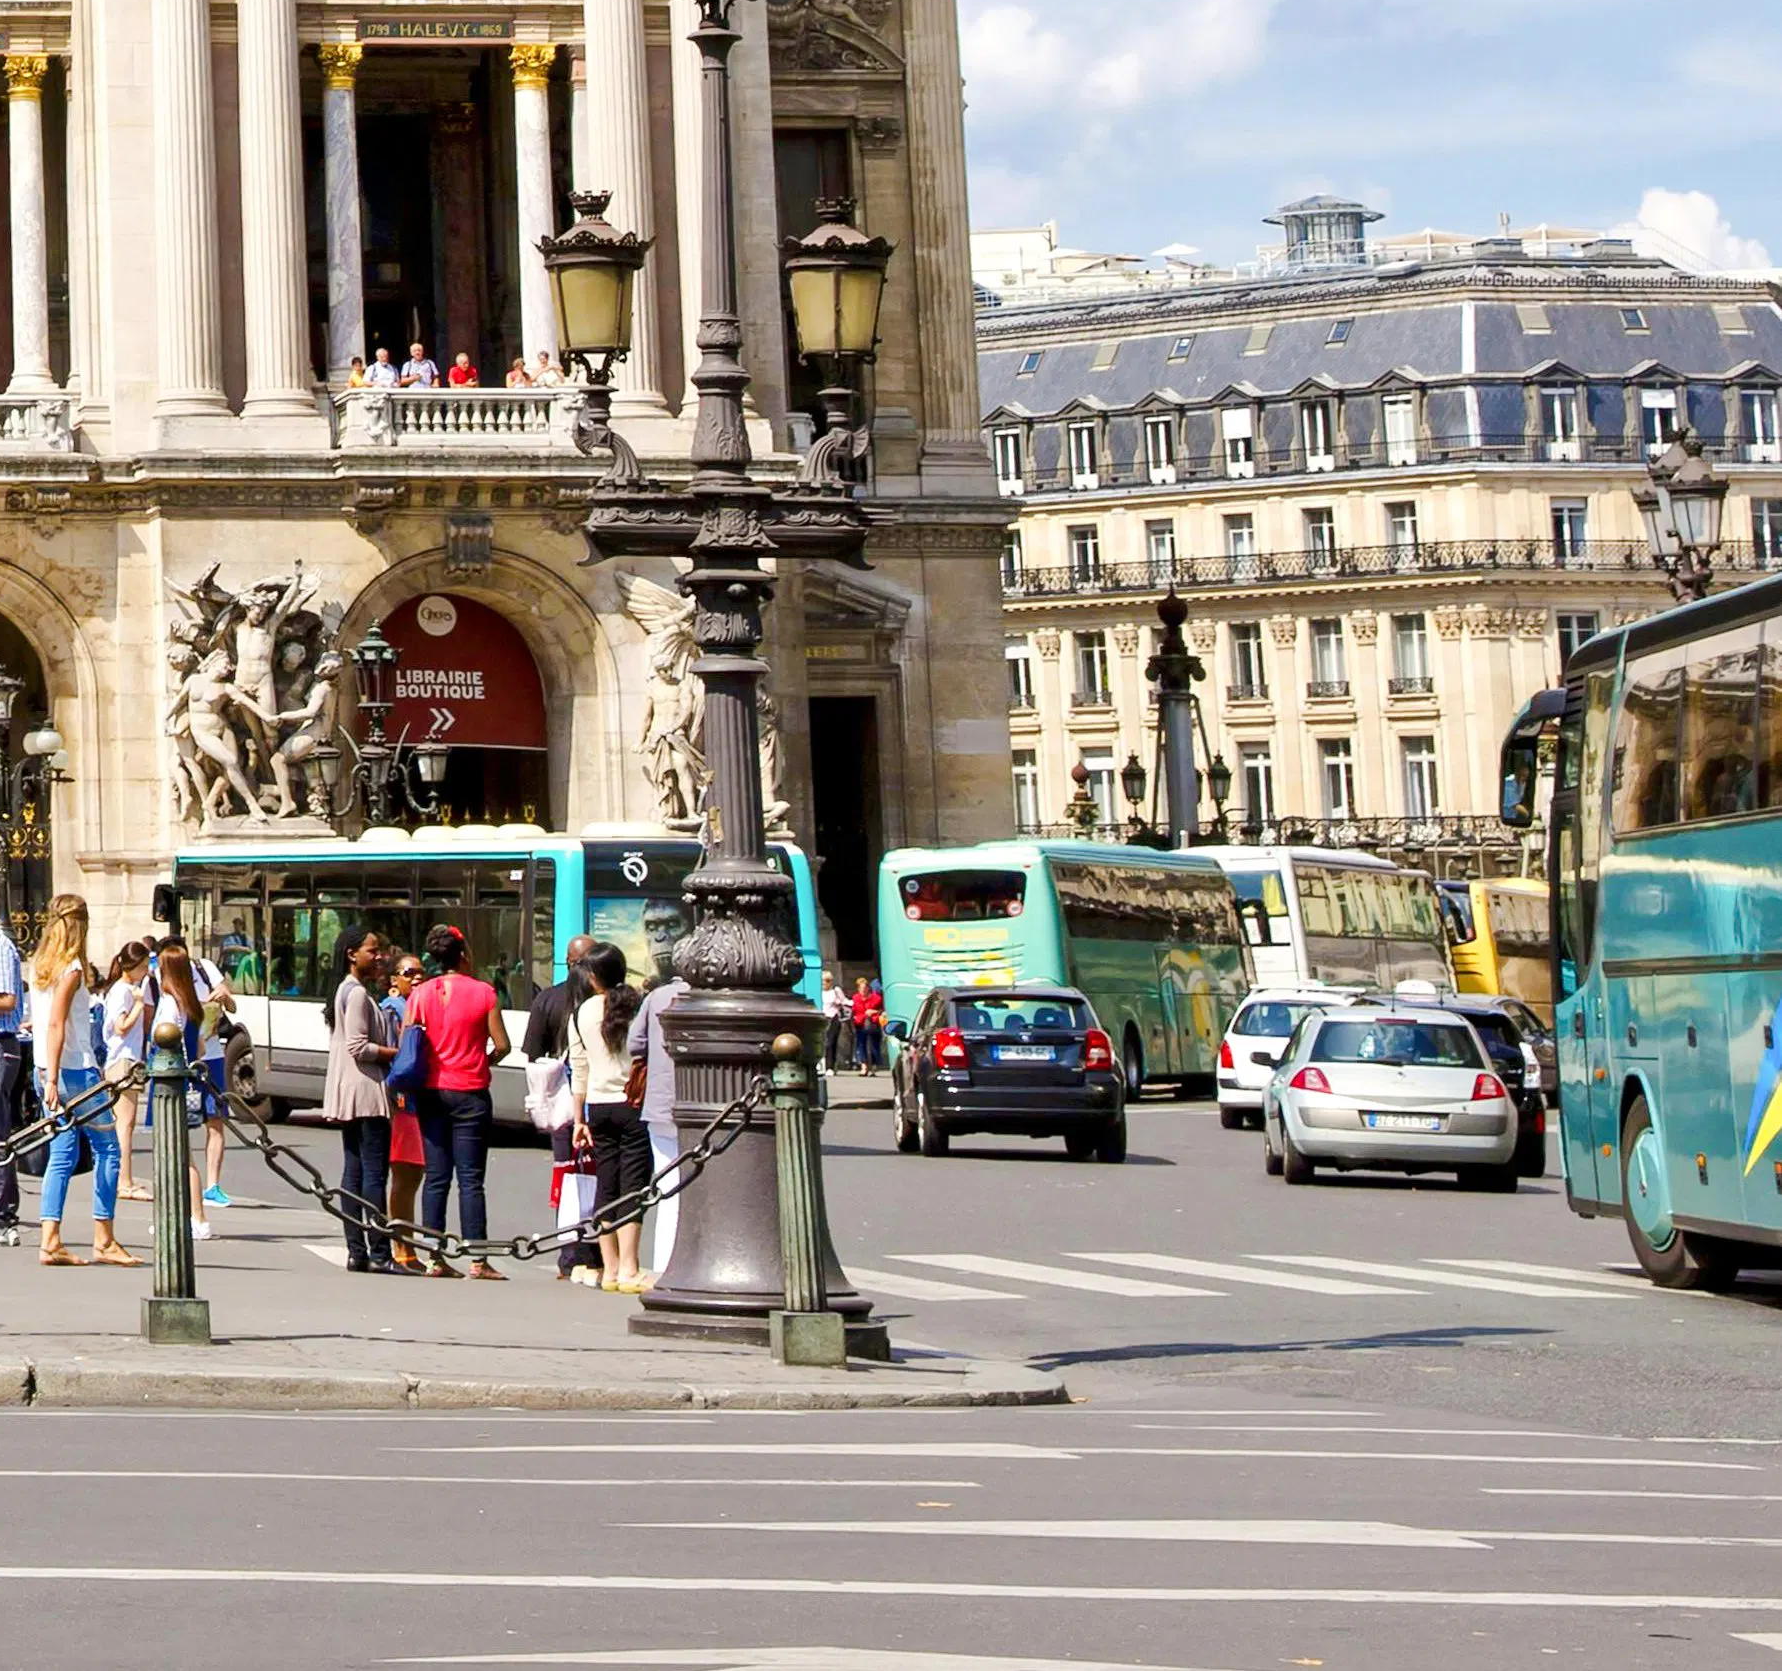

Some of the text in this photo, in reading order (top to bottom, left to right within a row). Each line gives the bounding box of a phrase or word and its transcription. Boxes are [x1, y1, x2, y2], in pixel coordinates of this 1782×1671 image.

[367, 24, 390, 36] 1799
[399, 23, 470, 37] HALEVY
[396, 670, 483, 685] LIBRAIRIE
[396, 685, 485, 700] BOUTIQUE
